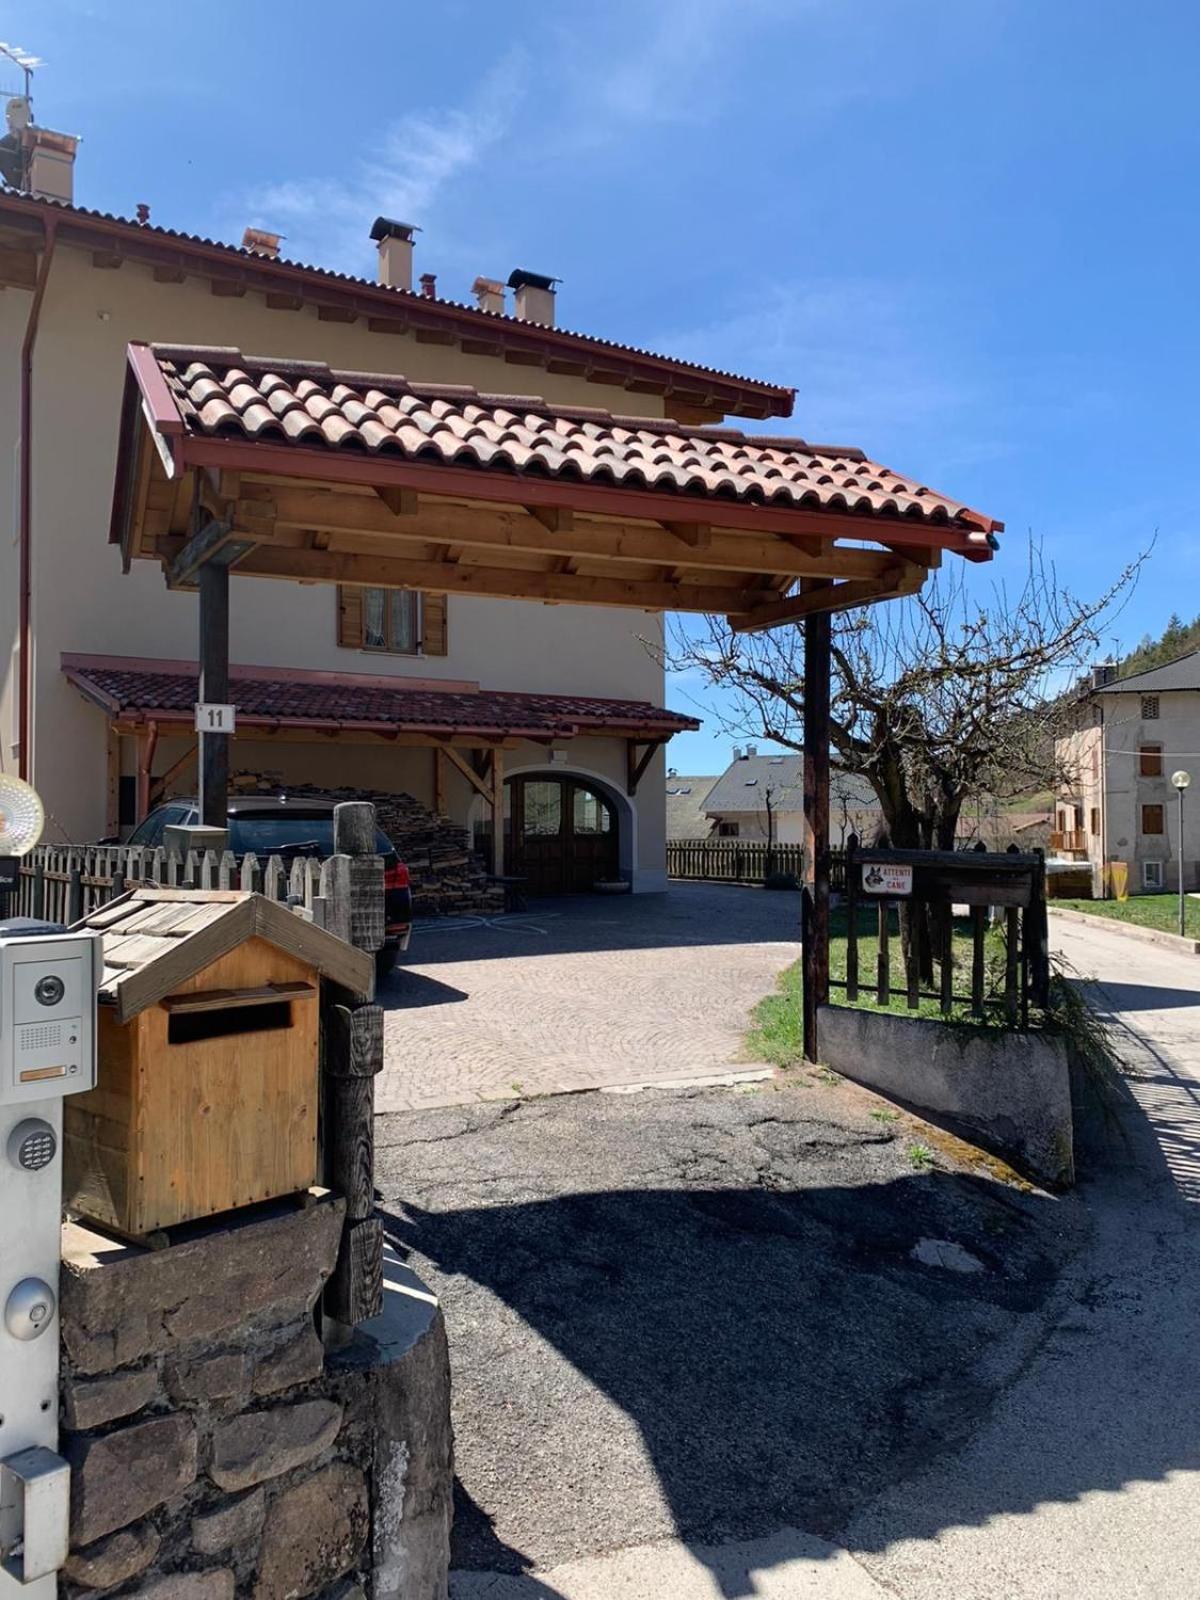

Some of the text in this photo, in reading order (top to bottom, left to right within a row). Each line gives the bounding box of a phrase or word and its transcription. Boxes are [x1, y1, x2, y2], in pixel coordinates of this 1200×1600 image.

[208, 709, 223, 727] 11
[883, 868, 911, 877] ATTENTI
[886, 881, 905, 889] CANE
